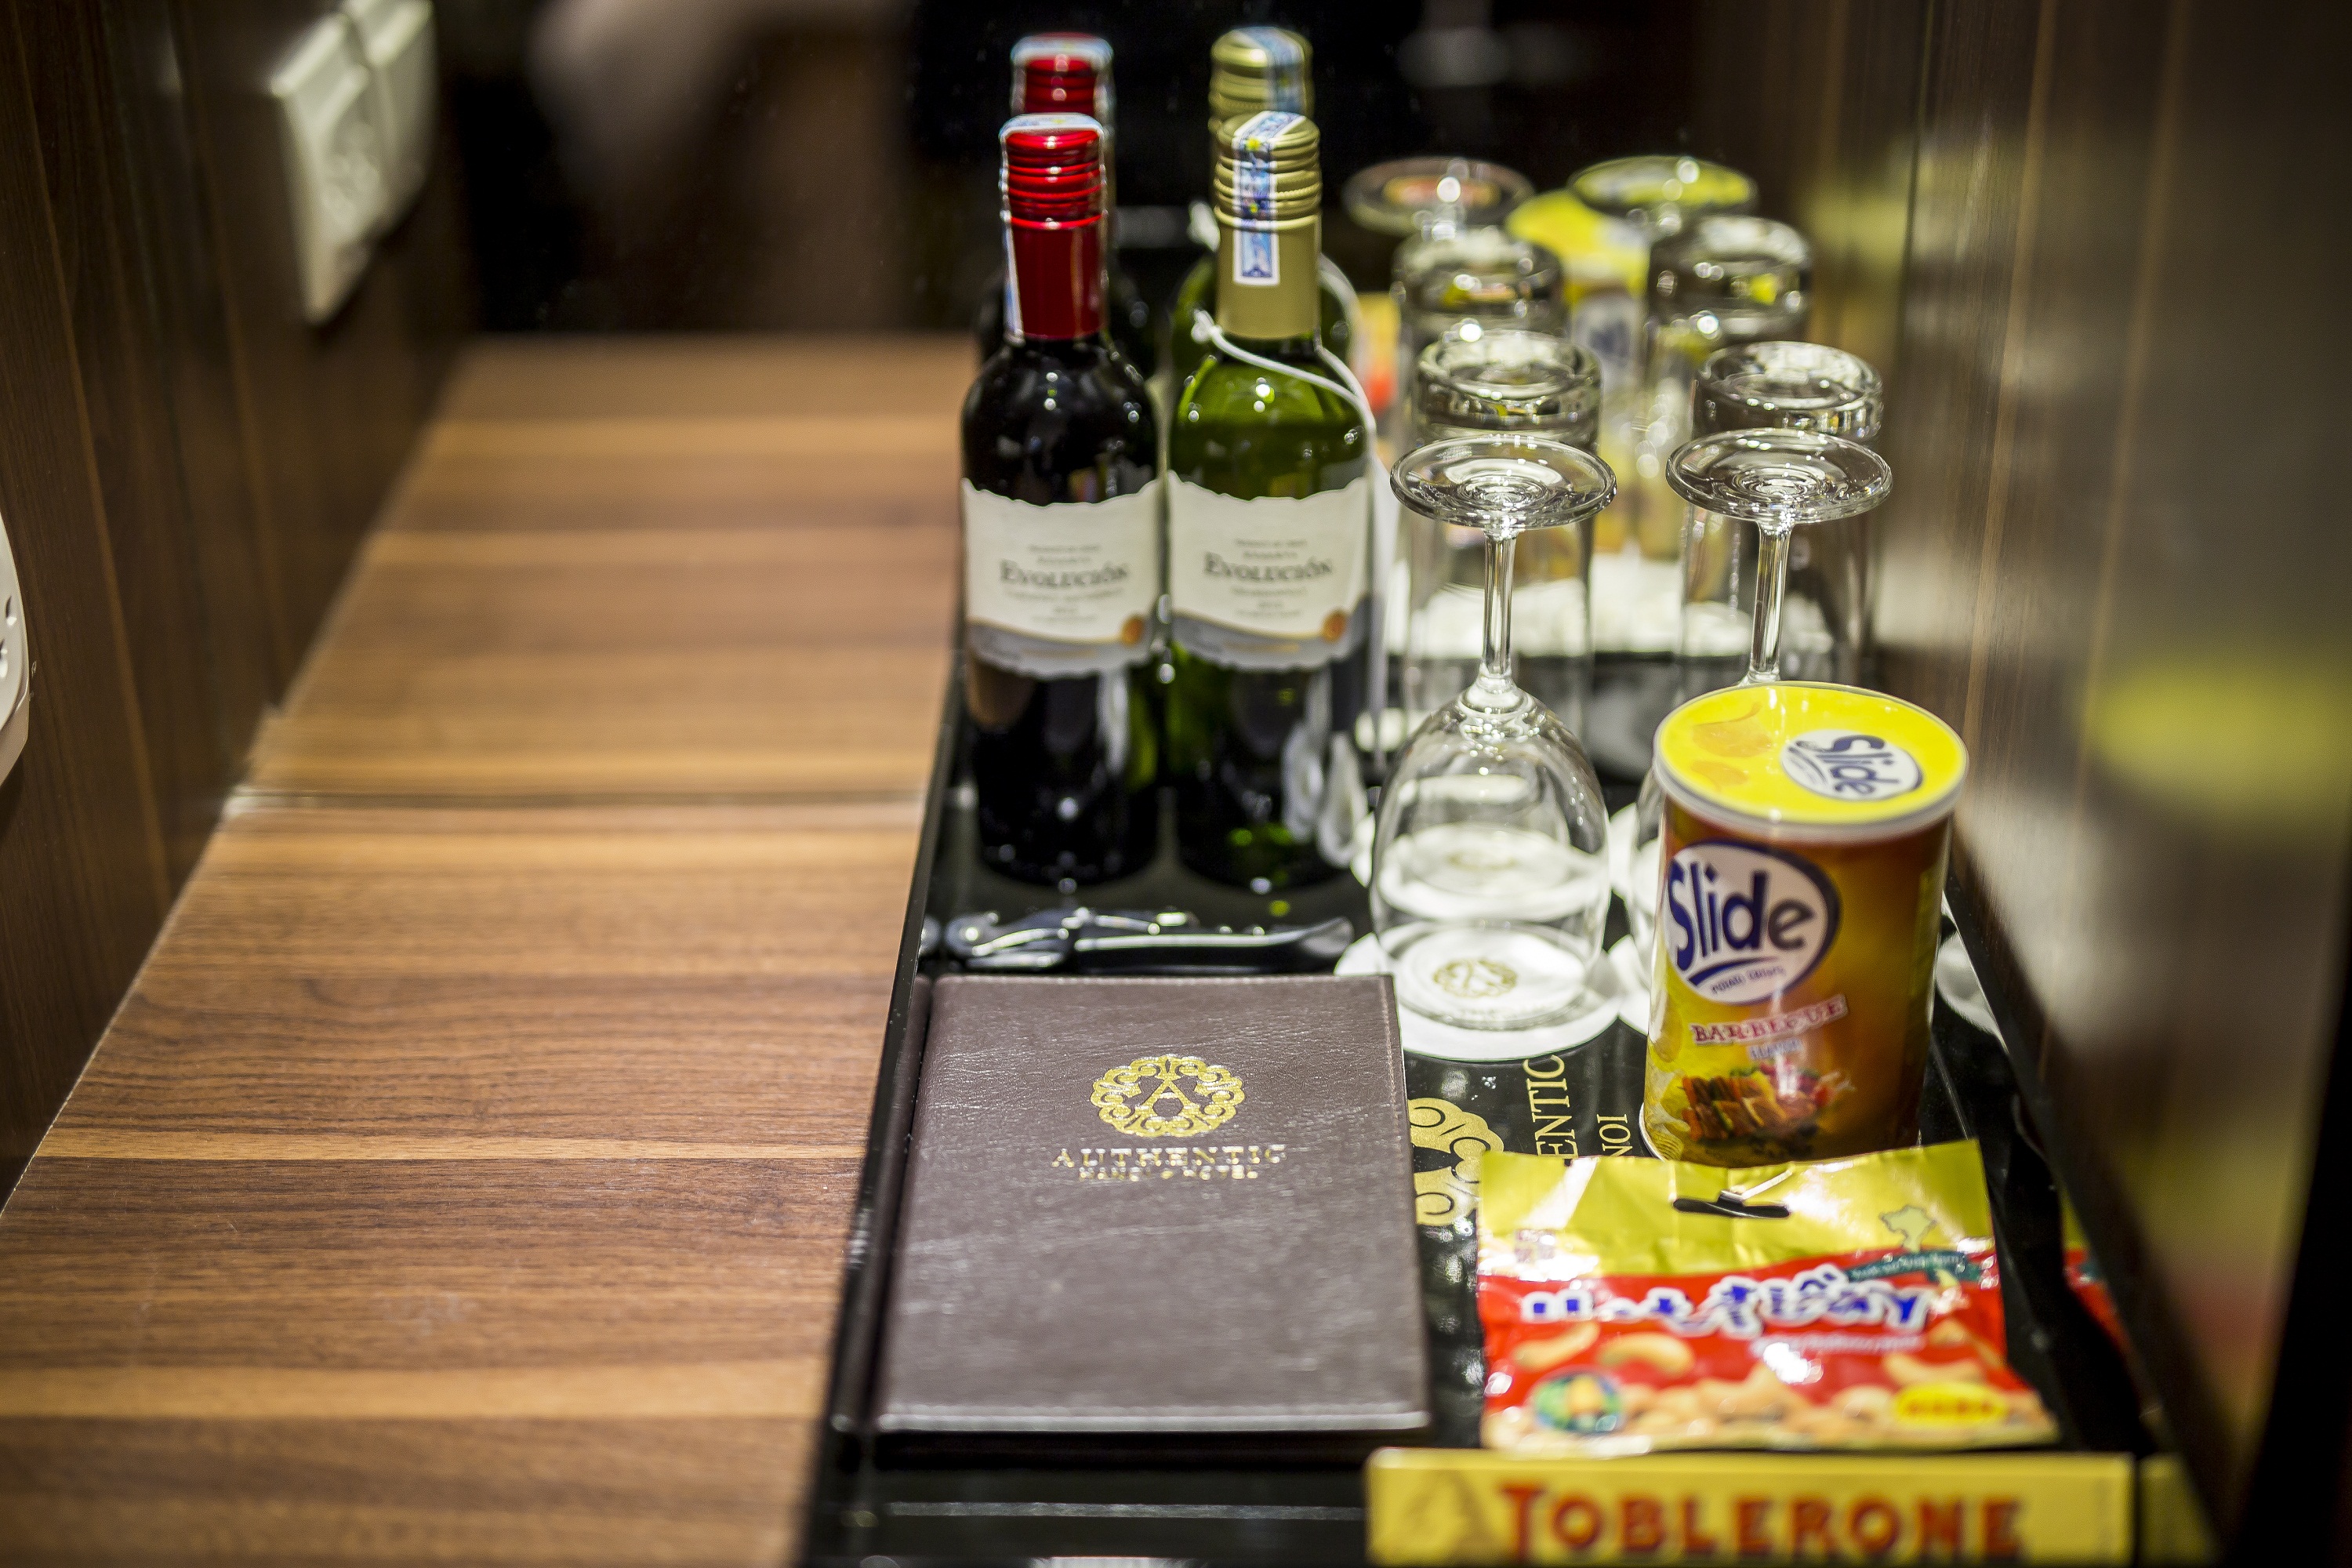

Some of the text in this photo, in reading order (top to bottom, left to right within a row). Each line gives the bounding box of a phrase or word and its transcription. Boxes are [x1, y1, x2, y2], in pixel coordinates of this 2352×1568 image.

[1795, 735, 1900, 795] Slide
[1667, 859, 1814, 971] Slide
[1690, 996, 1846, 1044] BARBECUE
[1051, 1144, 1288, 1168] AUTHENTIC
[1501, 1485, 2024, 1565] TOBLERONE
